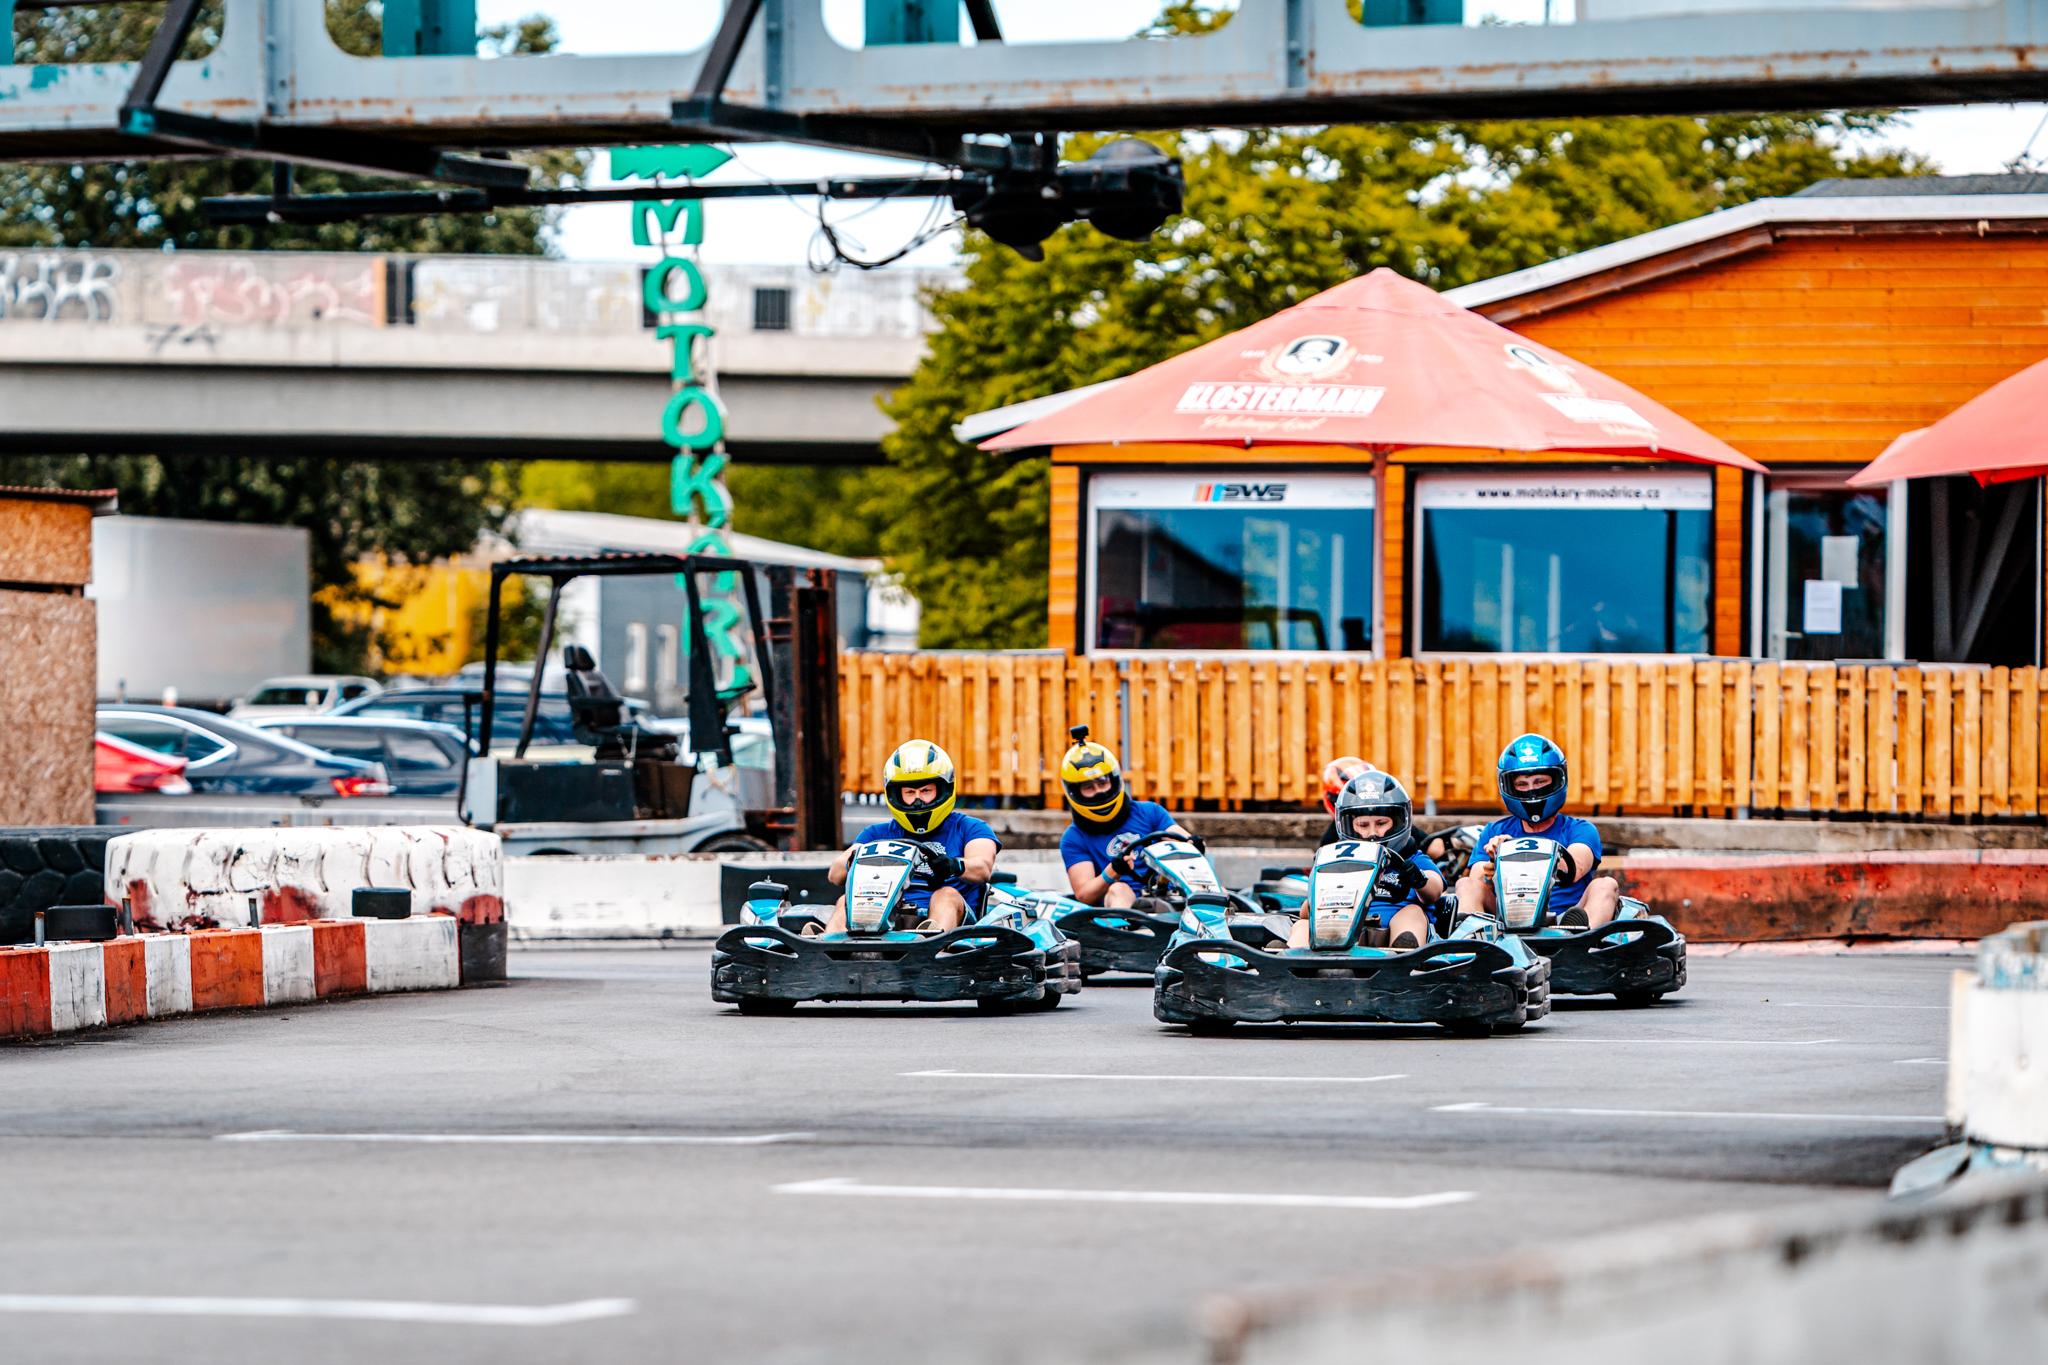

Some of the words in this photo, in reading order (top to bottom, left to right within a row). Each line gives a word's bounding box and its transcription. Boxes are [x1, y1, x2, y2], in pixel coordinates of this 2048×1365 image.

[1176, 385, 1384, 413] KLOSTERMANN
[1477, 485, 1661, 501] www.motokary-modrice.cz
[861, 842, 912, 857] 17
[1335, 842, 1361, 858] 7
[1515, 839, 1539, 850] 3
